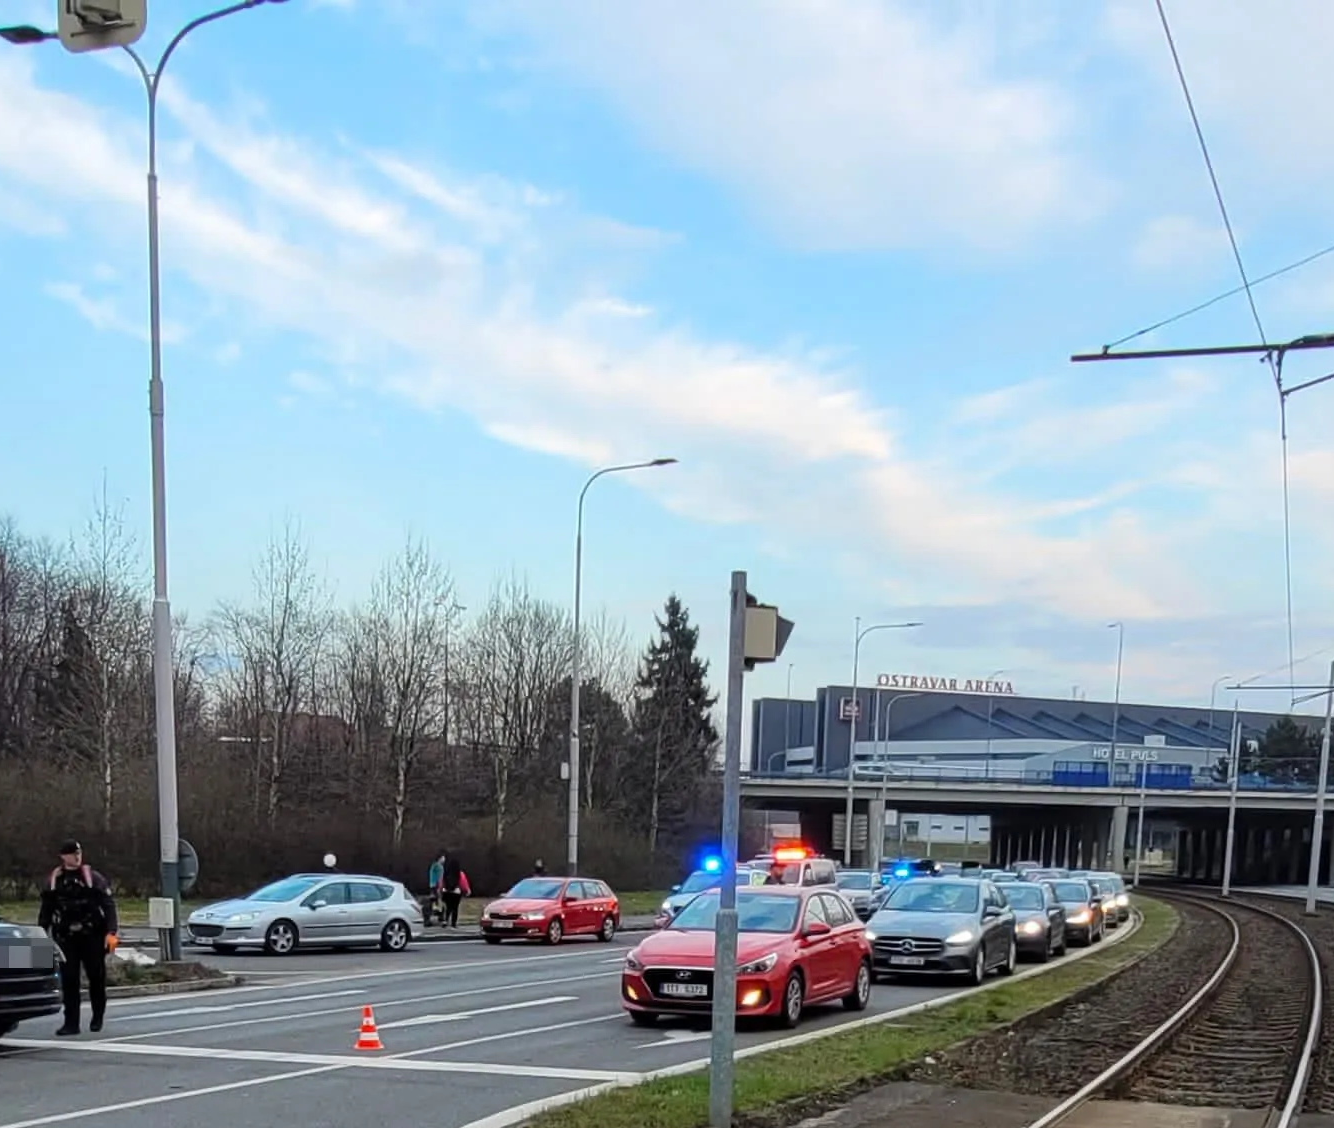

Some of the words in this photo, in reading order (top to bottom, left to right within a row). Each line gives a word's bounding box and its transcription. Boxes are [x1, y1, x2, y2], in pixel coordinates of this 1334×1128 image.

[877, 673, 958, 691] OSTRAVAR
[964, 679, 1014, 694] ARENA
[1093, 746, 1128, 760] HOEL
[1130, 750, 1158, 761] PULS
